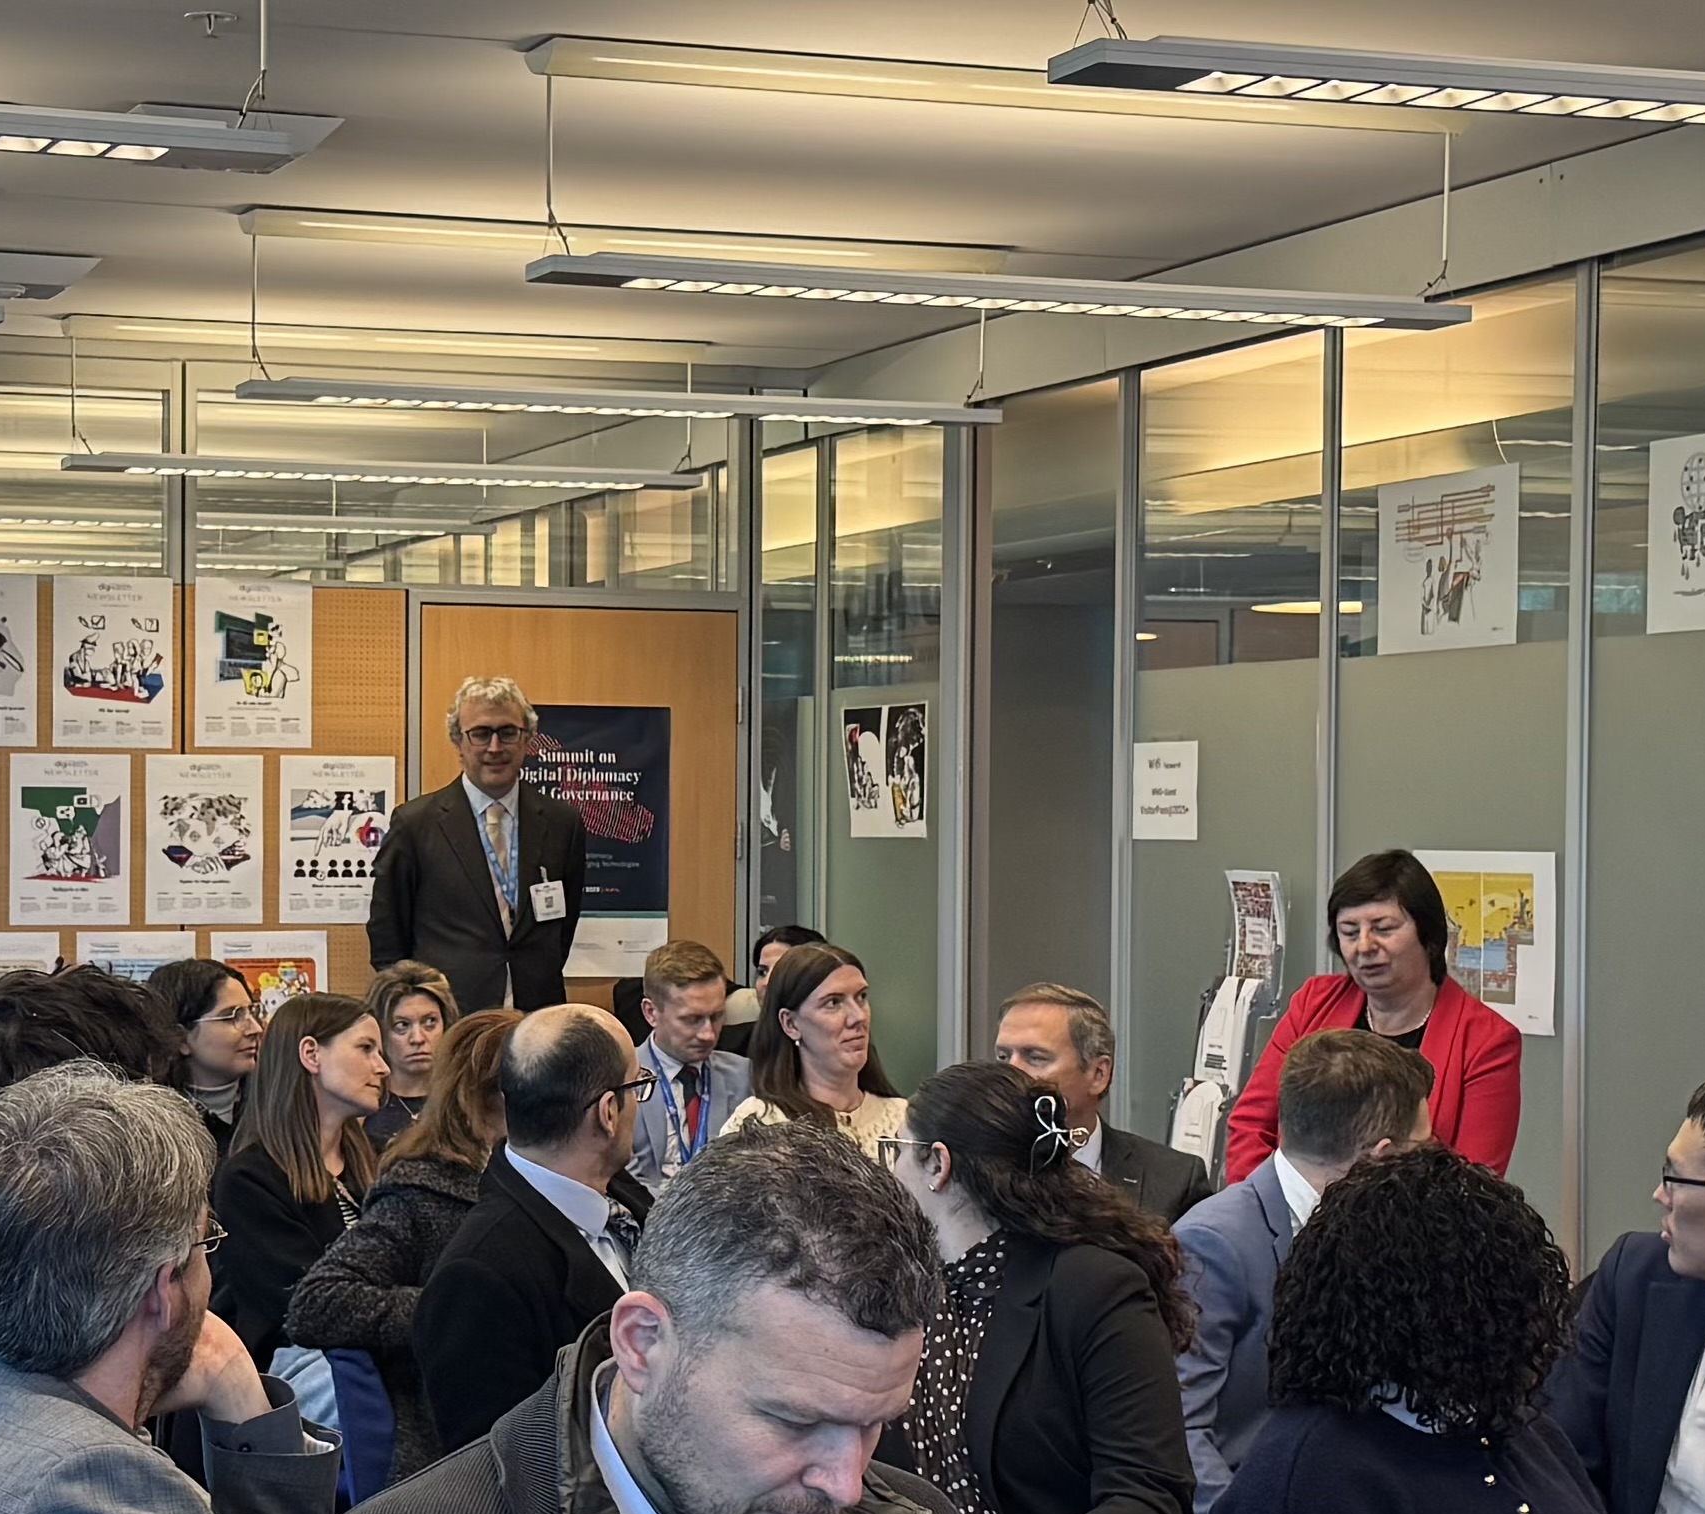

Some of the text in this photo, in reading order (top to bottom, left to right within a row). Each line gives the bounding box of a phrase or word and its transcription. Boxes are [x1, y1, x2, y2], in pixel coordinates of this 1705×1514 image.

[538, 749, 616, 763] Summit on
[567, 768, 641, 785] Diplomacy
[551, 787, 634, 801] Governance
